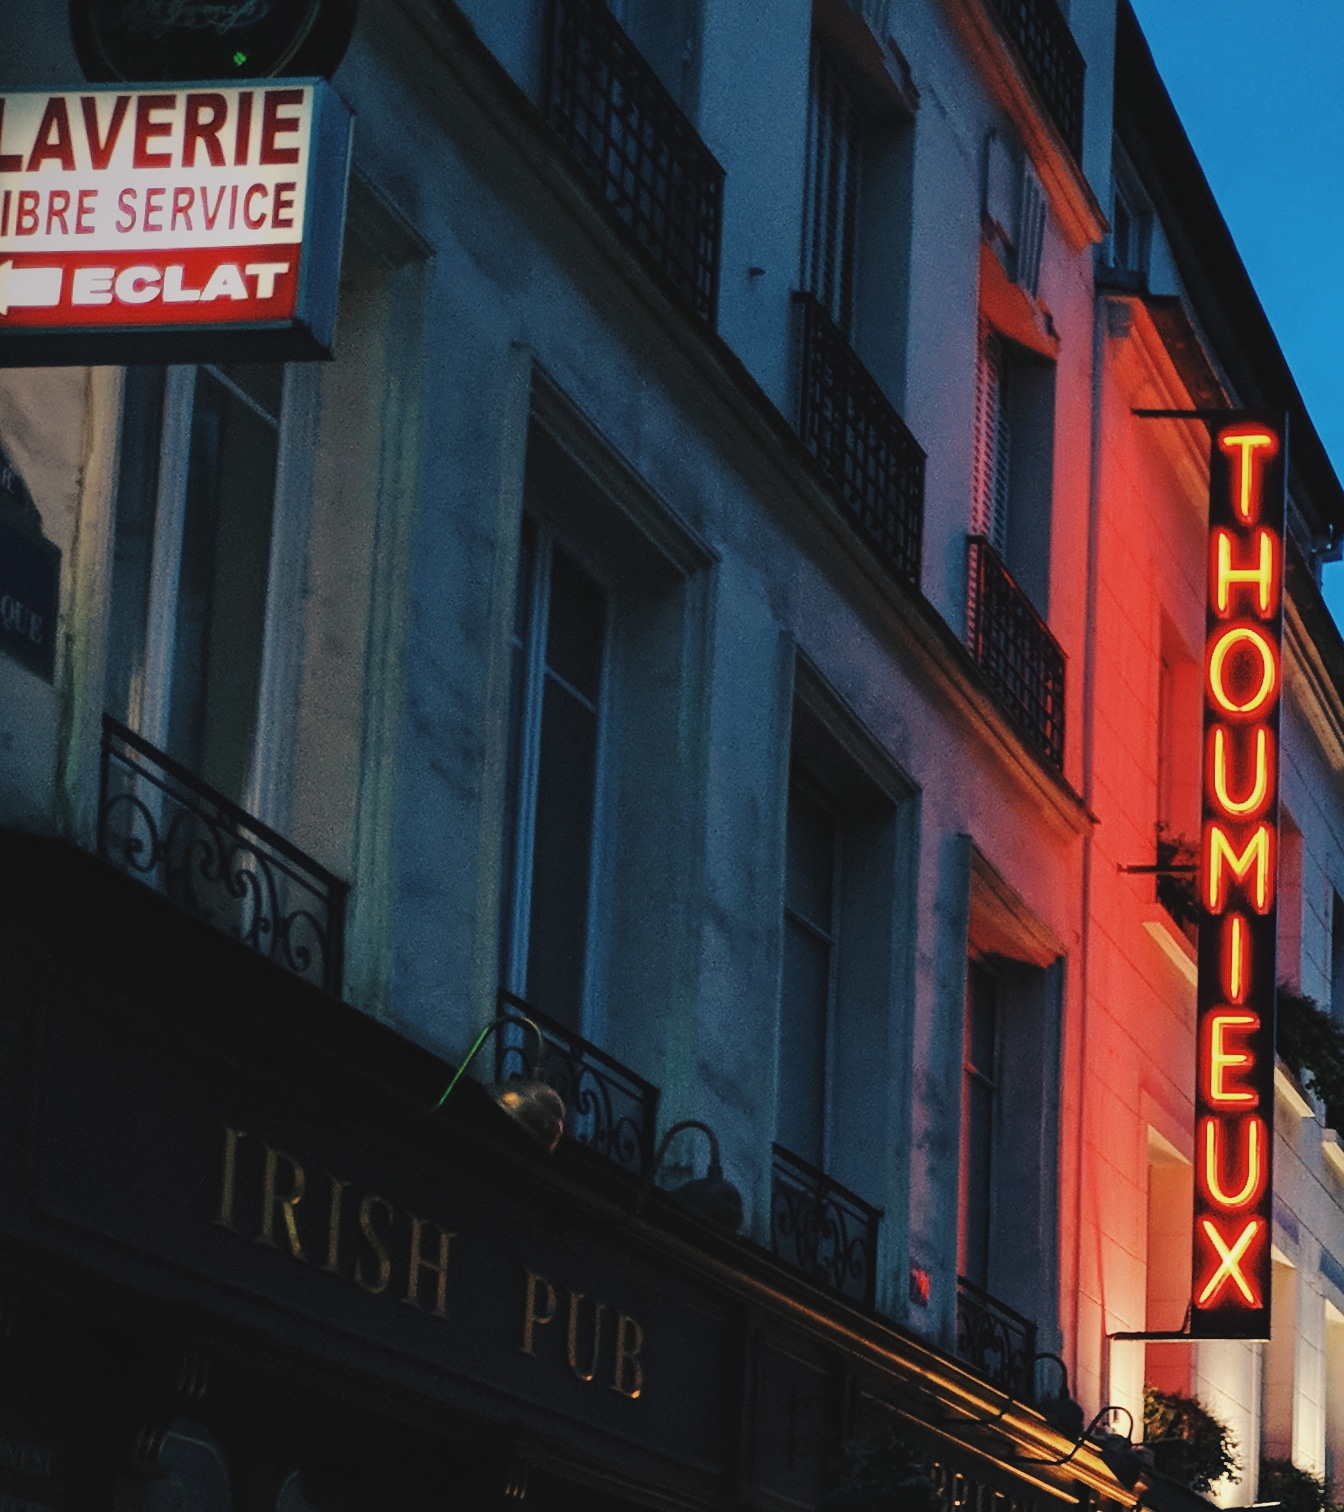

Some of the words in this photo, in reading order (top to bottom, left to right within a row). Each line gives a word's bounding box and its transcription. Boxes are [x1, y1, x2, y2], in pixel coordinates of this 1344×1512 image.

[0, 89, 304, 172] LAVERIE
[0, 189, 98, 236] IBRE
[115, 182, 297, 233] SERVICE
[72, 262, 290, 306] ECLAT
[1200, 432, 1276, 1308] THOUMIEUX
[213, 1123, 459, 1322] IRISH
[519, 1267, 645, 1399] PUB
